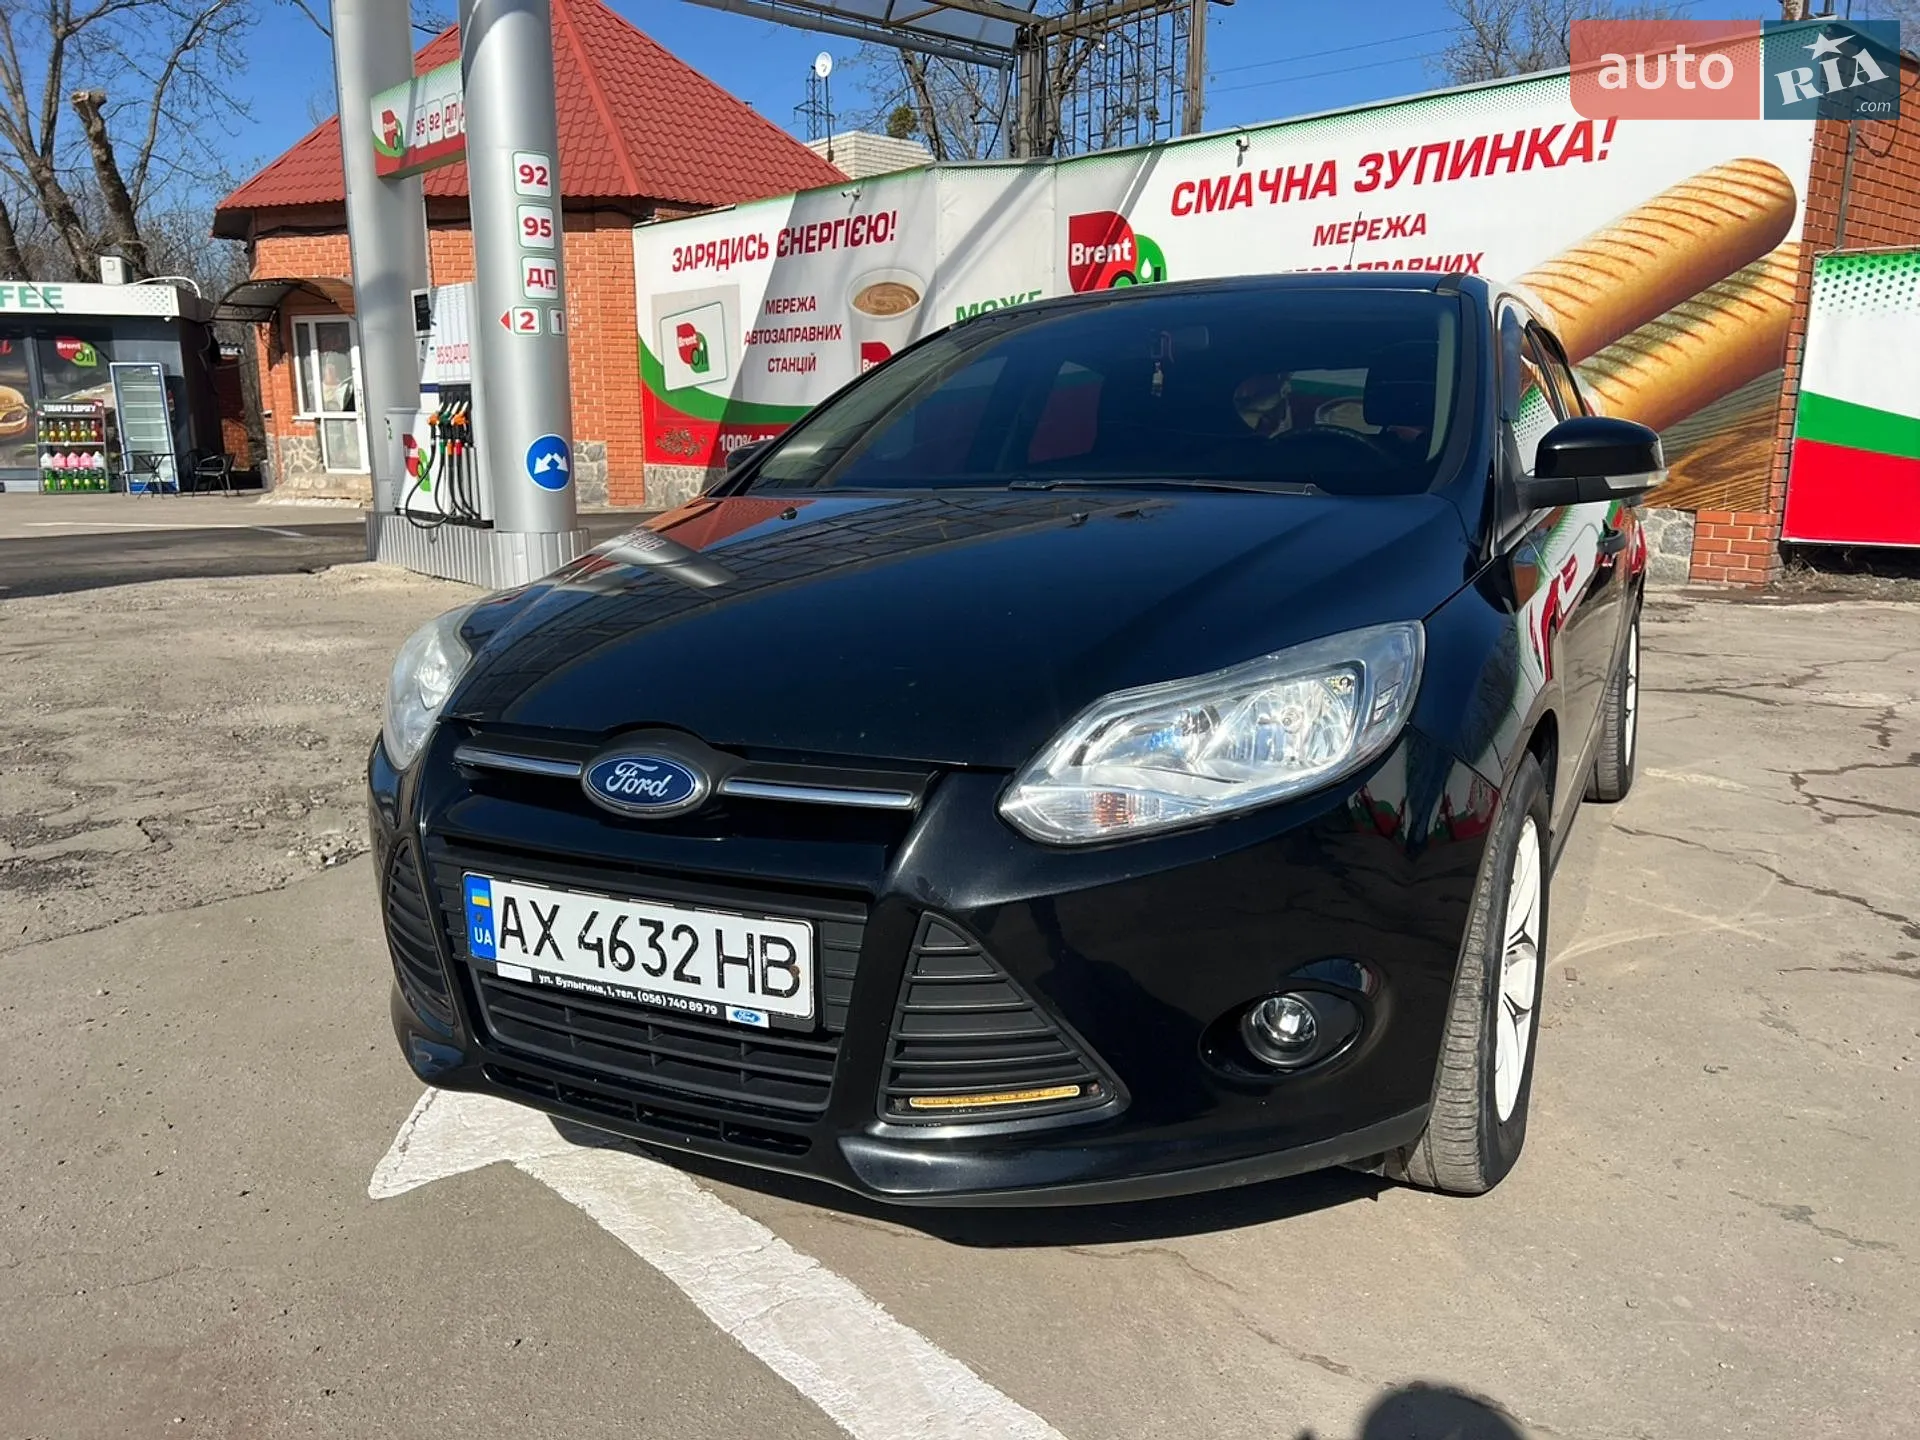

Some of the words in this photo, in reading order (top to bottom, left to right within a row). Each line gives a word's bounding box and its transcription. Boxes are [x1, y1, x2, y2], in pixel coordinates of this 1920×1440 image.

[429, 112, 440, 131] 92
[518, 164, 548, 186] 92
[1170, 160, 1338, 217] СМАЧНА
[1353, 116, 1618, 193] ЗУПИНКА!
[523, 217, 552, 237] 95
[1313, 213, 1427, 246] МЕРЕЖА
[672, 233, 769, 272] ЗАРЯДИСЬ
[777, 210, 898, 258] ЄНЕРГІЄЮ!
[1071, 236, 1132, 267] Brent
[527, 268, 557, 287] ДП
[765, 296, 816, 315] МЕРЕЖА
[520, 311, 535, 330] 2
[556, 313, 563, 331] 1
[744, 324, 842, 346] АВТОЗАПРАВНИХ
[767, 352, 817, 375] СТАНЦІЙ
[605, 761, 673, 797] Ford
[474, 927, 493, 946] UA
[500, 896, 564, 961] AX
[577, 910, 702, 985] 4632
[715, 928, 801, 998] HB
[667, 997, 688, 1010] 740
[688, 1000, 704, 1013] 89
[704, 1003, 718, 1016] 79
